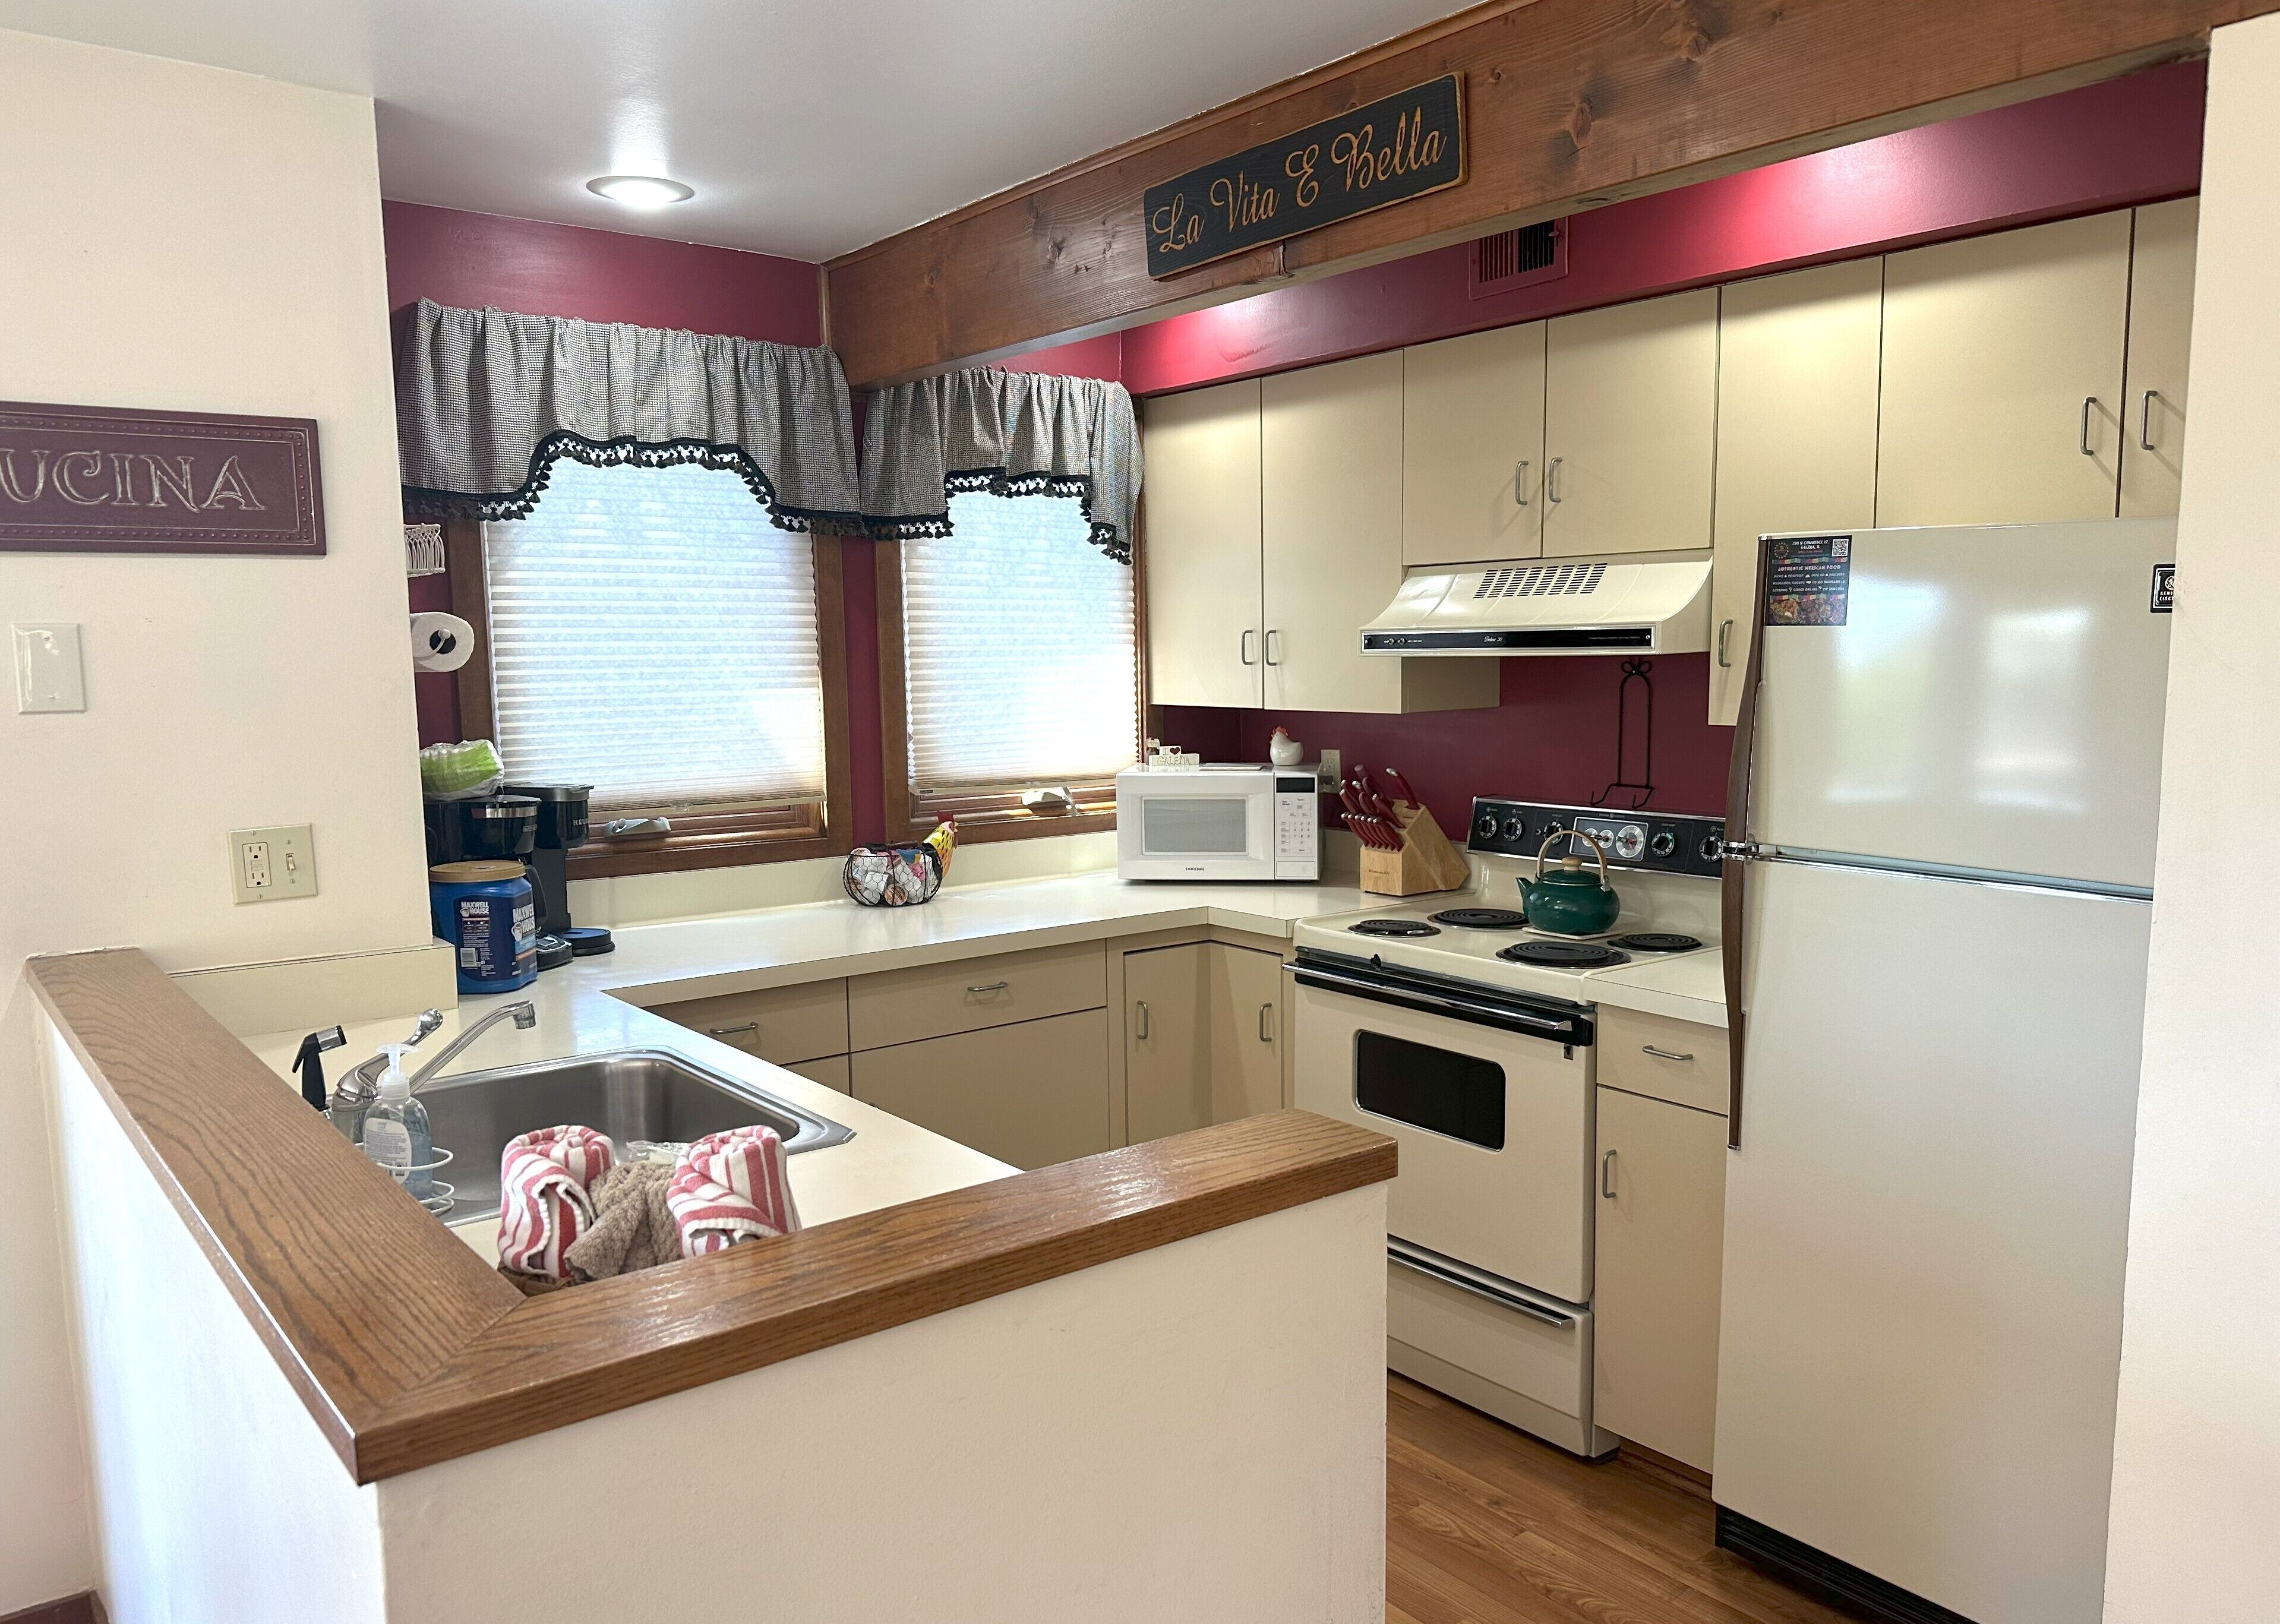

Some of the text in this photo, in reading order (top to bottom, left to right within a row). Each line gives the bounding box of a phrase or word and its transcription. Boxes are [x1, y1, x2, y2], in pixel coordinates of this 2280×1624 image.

[1152, 106, 1447, 252] La Vita E Bella
[0, 448, 266, 514] UCINA
